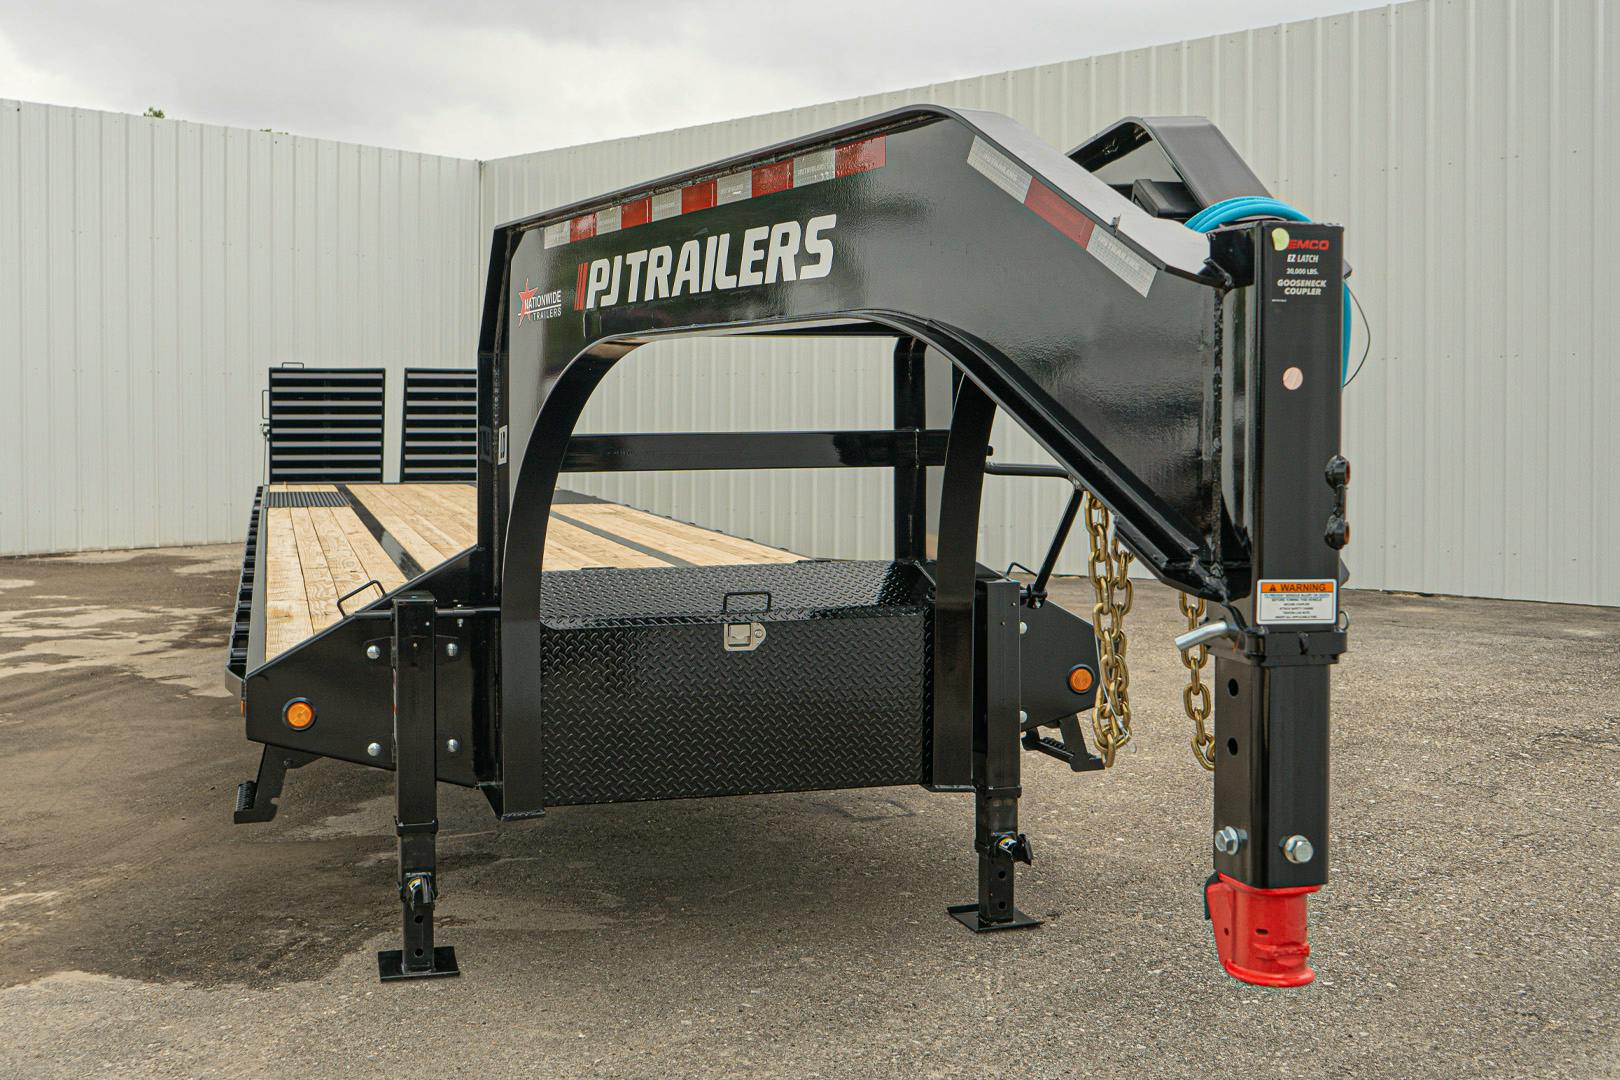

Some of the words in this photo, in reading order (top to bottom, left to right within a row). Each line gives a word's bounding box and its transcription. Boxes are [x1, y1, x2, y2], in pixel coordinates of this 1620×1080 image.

[1287, 239, 1329, 250] EMCO
[585, 255, 622, 309] PJ
[626, 213, 837, 303] TRAILERS
[1287, 254, 1296, 262] EZ
[1297, 254, 1319, 263] LATCH
[1277, 279, 1327, 288] GOOSENECK
[1284, 287, 1322, 295] COUPLER
[524, 289, 562, 310] NATIONWIDE
[533, 307, 562, 320] TRAILERS
